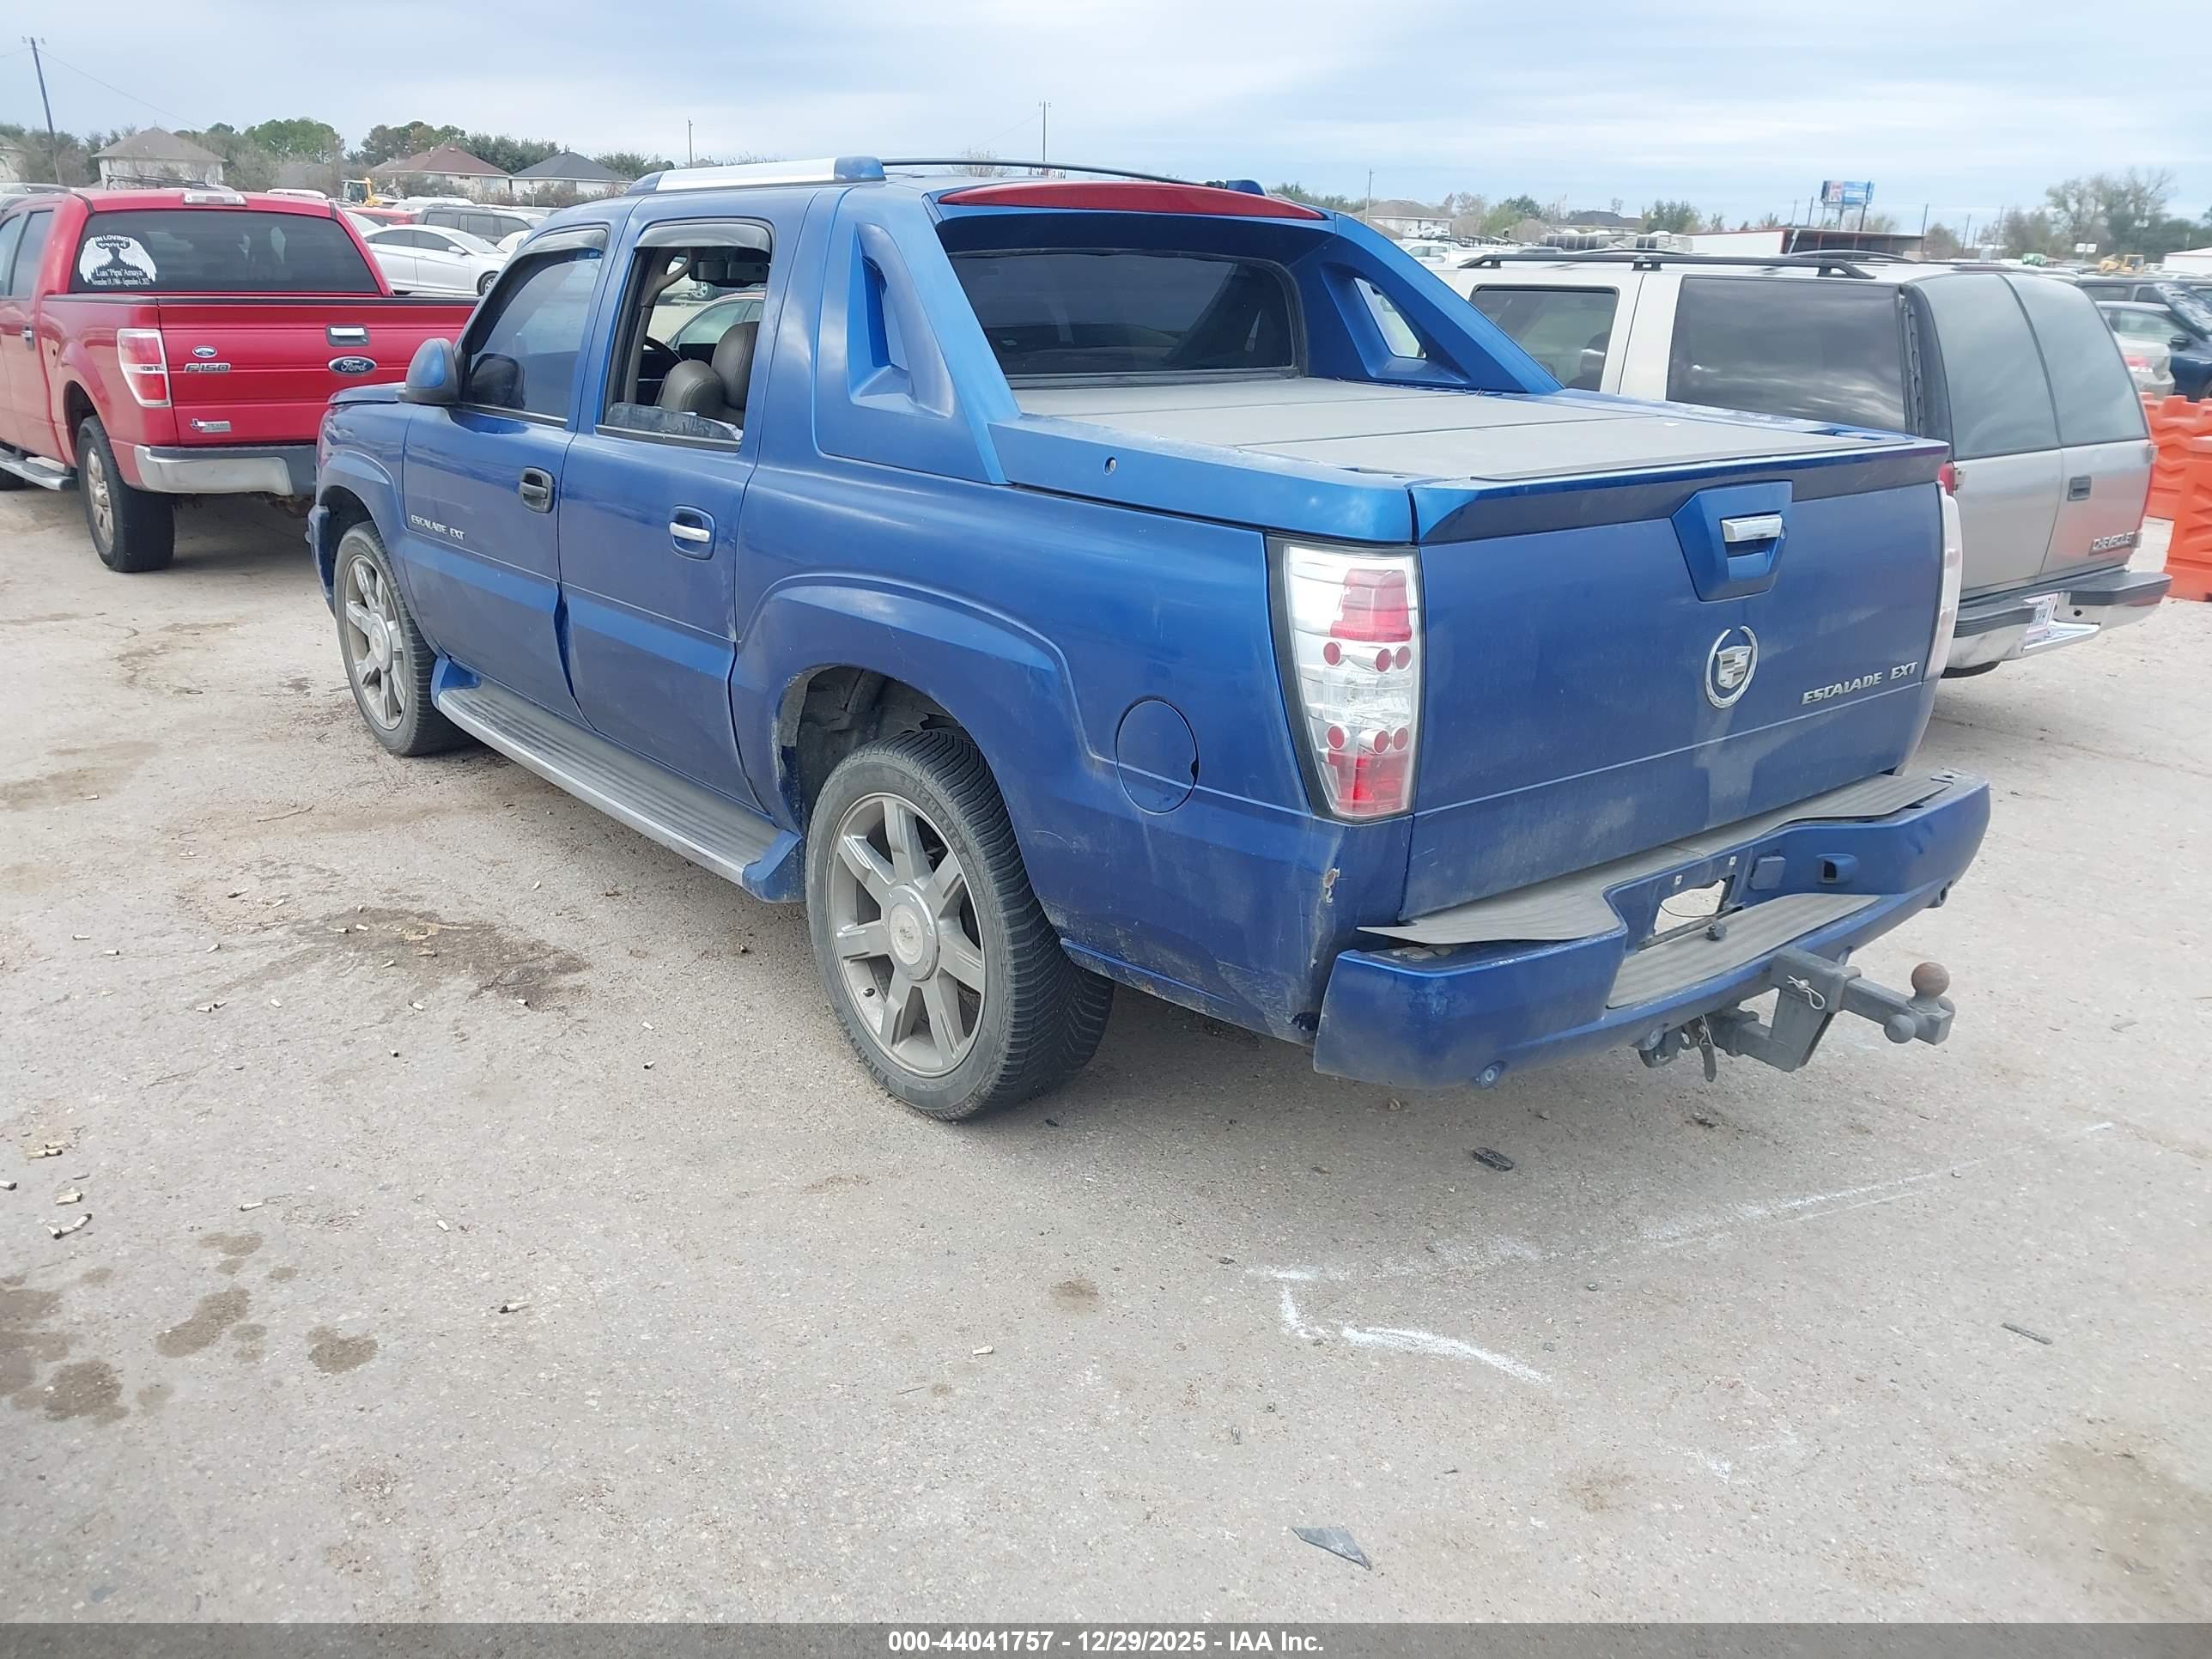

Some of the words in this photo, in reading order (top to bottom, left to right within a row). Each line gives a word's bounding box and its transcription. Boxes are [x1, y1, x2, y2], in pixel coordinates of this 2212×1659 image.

[341, 360, 367, 371] Ford
[449, 527, 465, 540] EXT
[1802, 672, 1883, 705] ESCALADE
[1890, 661, 1918, 680] EXT
